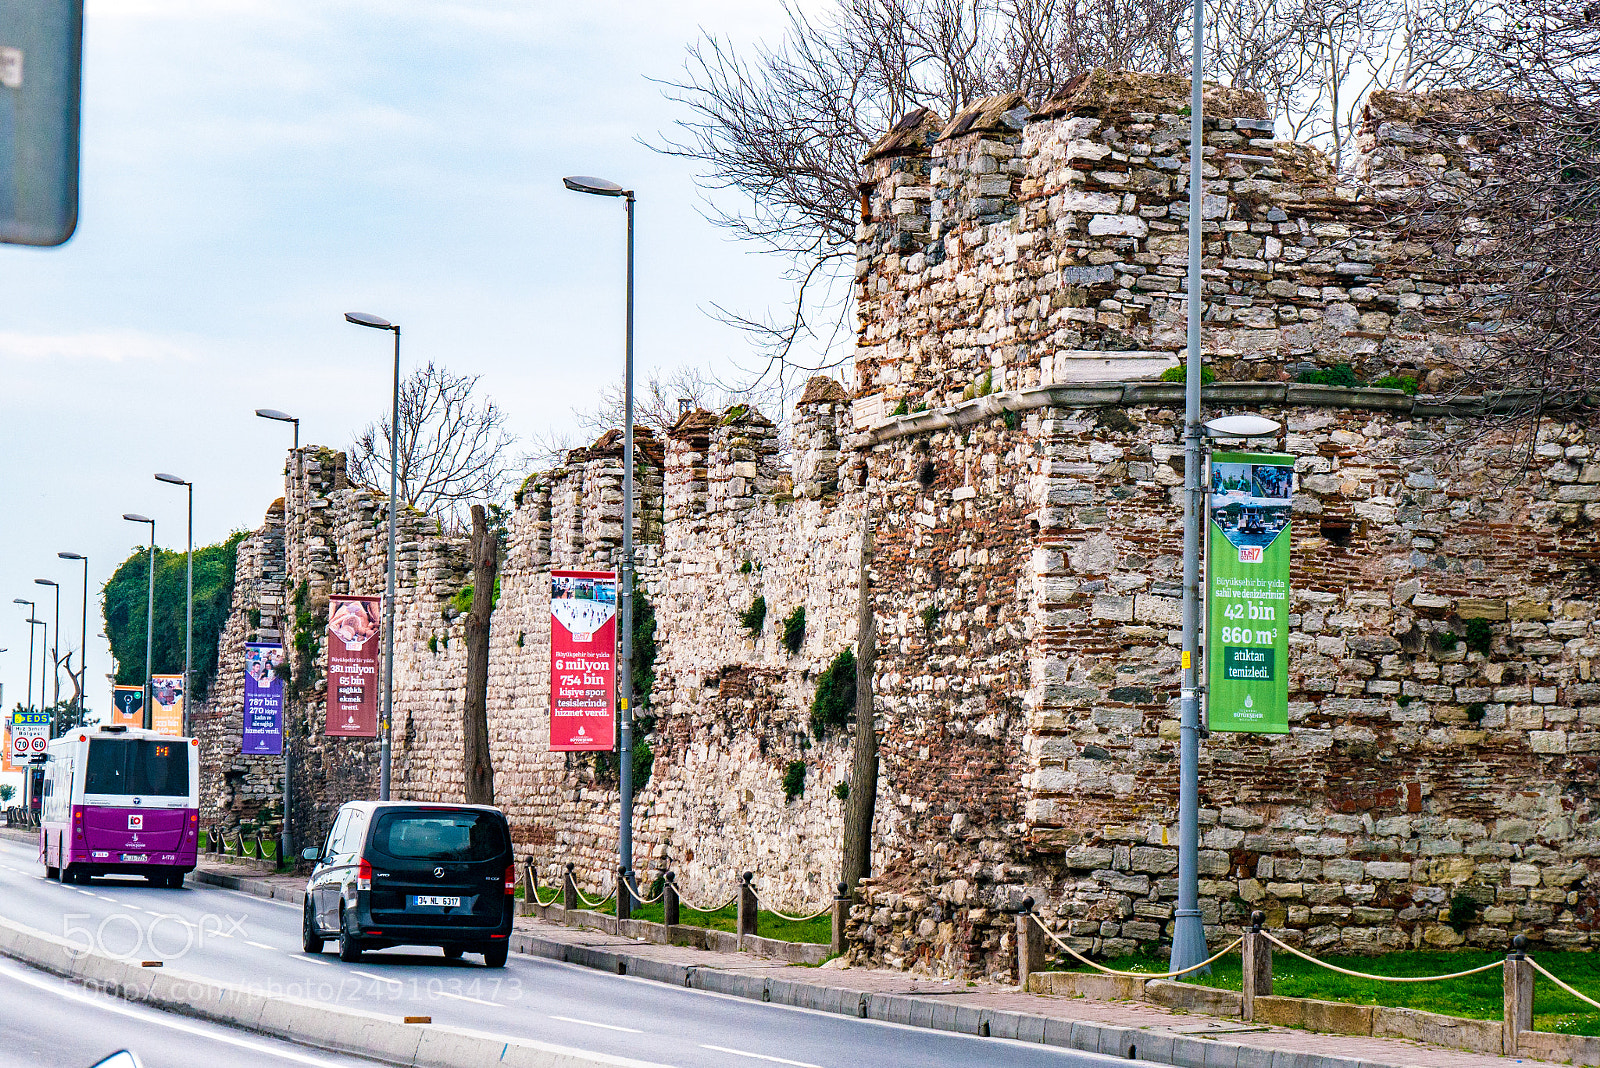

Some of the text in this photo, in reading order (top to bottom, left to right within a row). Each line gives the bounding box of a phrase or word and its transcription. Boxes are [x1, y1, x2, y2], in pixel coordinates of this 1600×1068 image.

[1256, 578, 1267, 587] bir
[1215, 587, 1285, 600] sahil ve denizlerimizi
[1224, 601, 1275, 621] 42 bin
[1221, 626, 1253, 644] 860
[1234, 649, 1265, 662] atıktan
[330, 663, 375, 676] 381 milyon
[555, 658, 610, 674] 6 milyon
[1228, 665, 1270, 679] temizledi.
[339, 675, 365, 686] 65 bin
[560, 672, 605, 686] 754 bin
[559, 687, 606, 698] kişiye spor
[248, 697, 278, 707] 787 bin
[557, 698, 607, 708] tesislerinde
[554, 708, 610, 717] hizmet verdi.
[26, 714, 47, 723] EDS
[17, 740, 27, 749] 70
[34, 740, 44, 749] 60
[418, 896, 459, 906] 34 NL 6317
